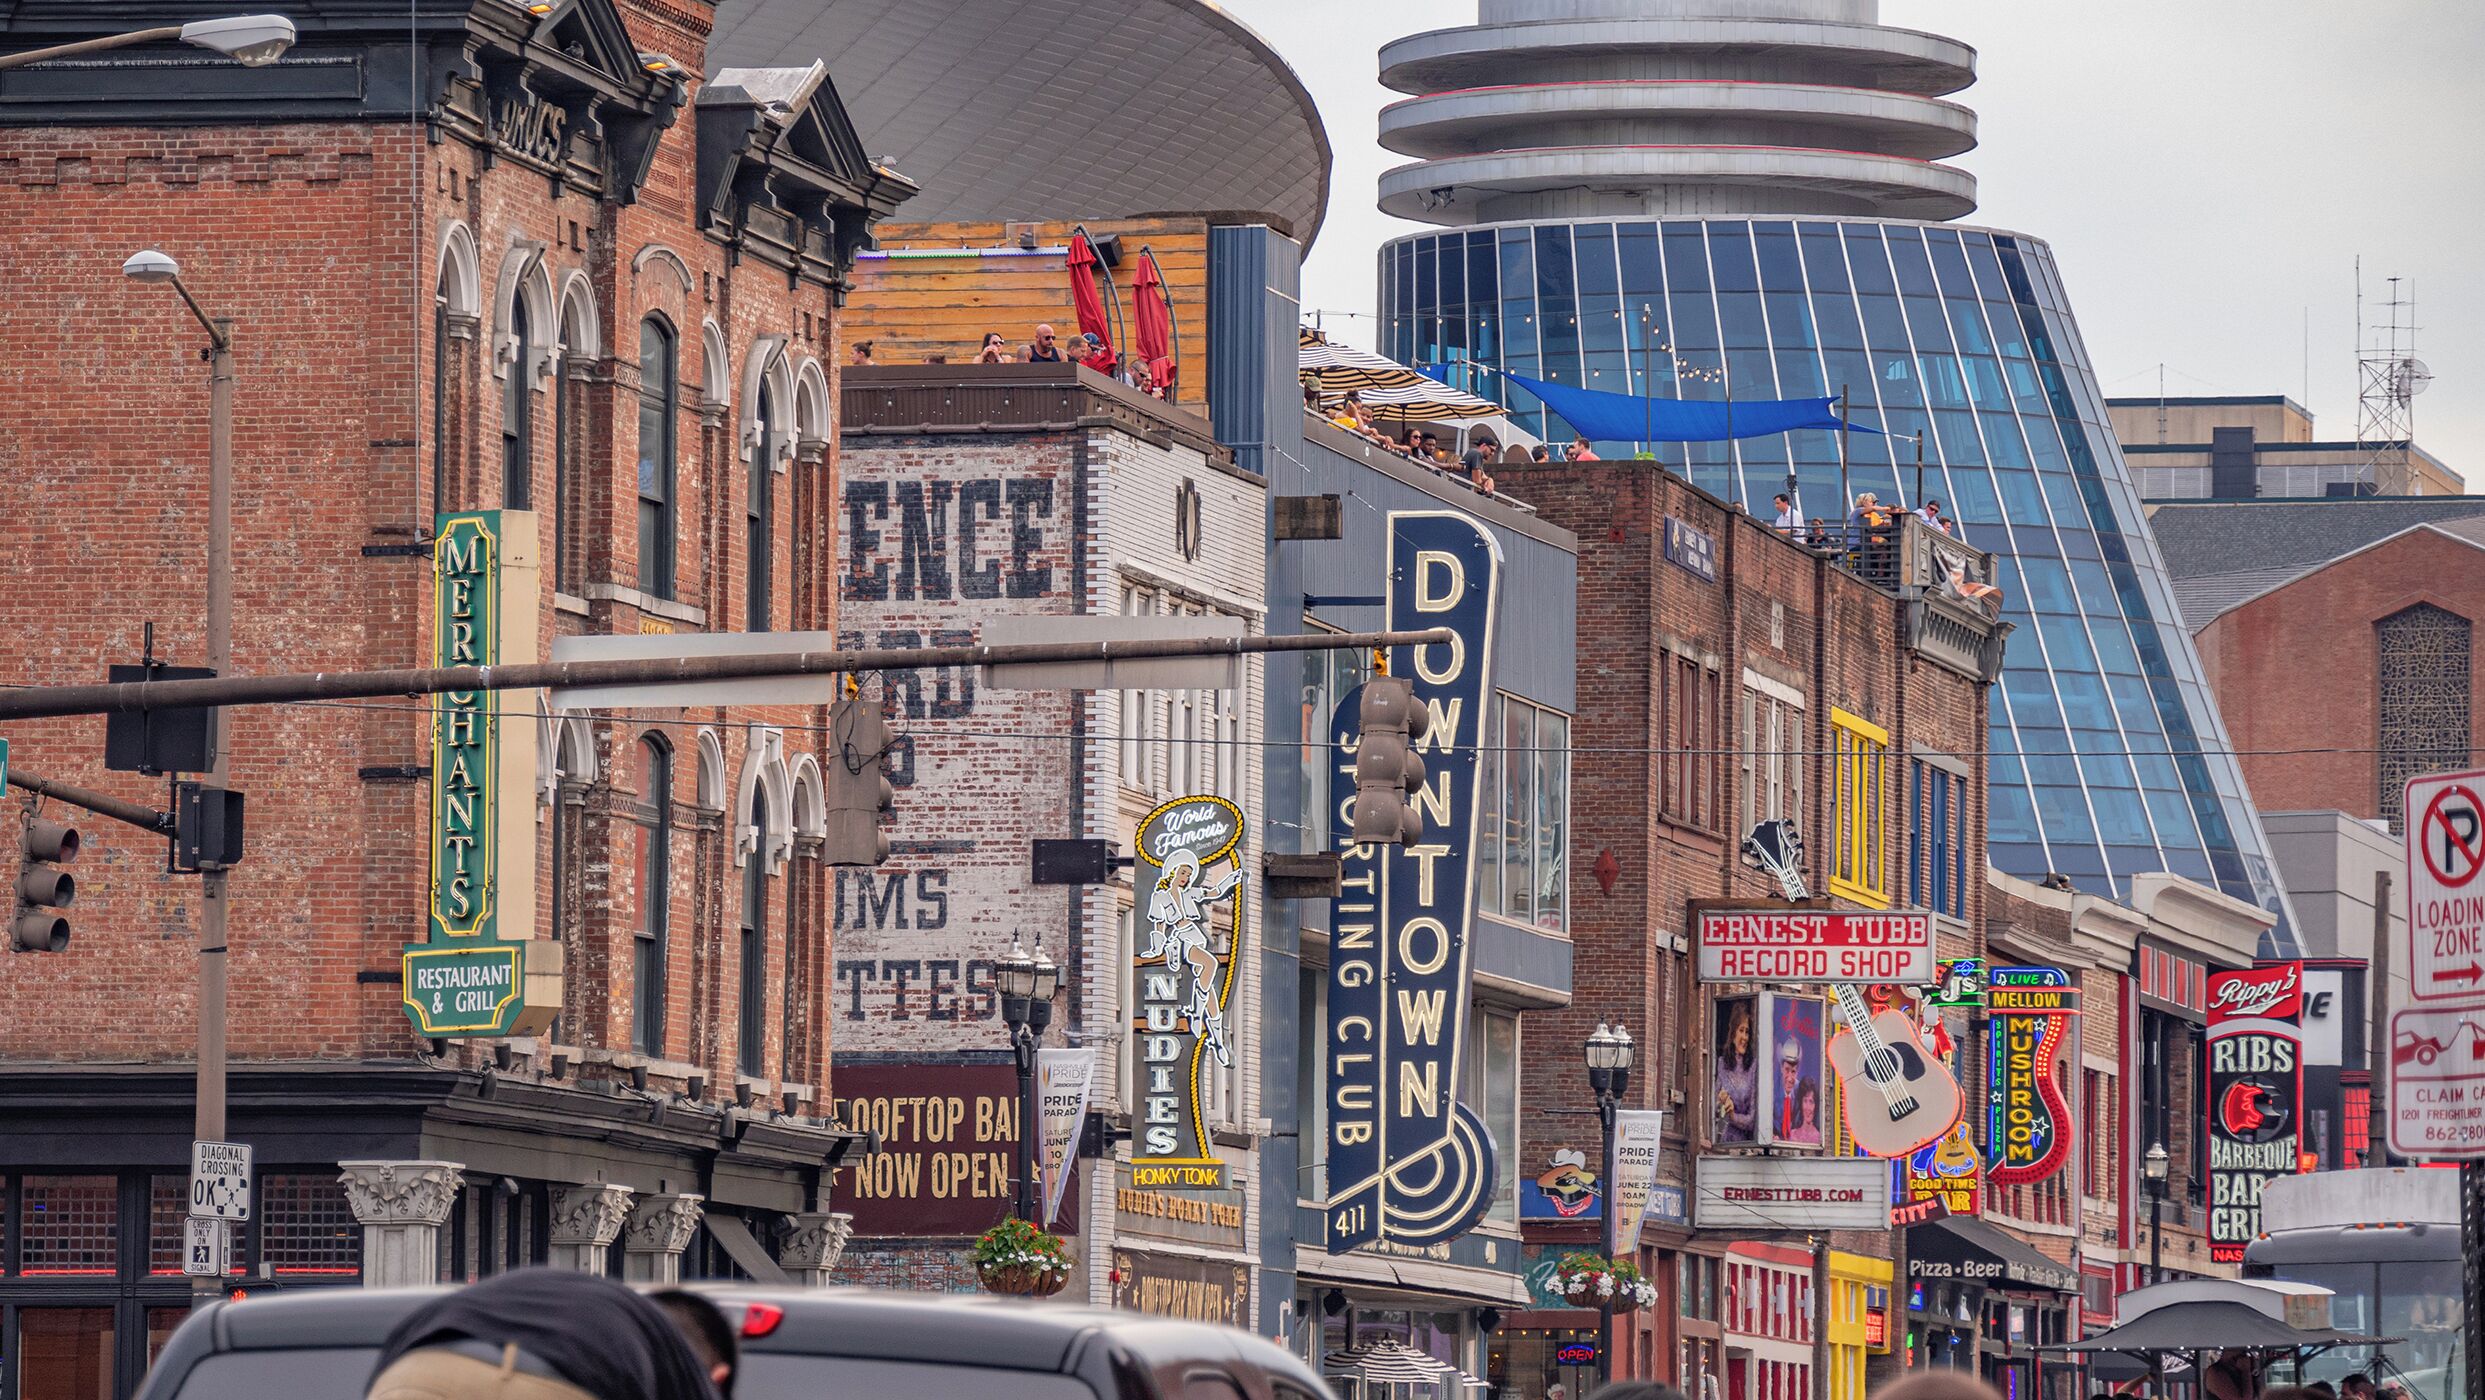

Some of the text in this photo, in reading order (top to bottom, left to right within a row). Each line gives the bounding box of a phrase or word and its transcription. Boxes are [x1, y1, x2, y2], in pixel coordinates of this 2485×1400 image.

[839, 479, 1053, 600] ENCE
[1164, 804, 1216, 832] World
[1154, 821, 1230, 857] Famous
[1397, 550, 1466, 1117] DOWNTOWN
[1705, 916, 1927, 944] ERNEST TUBB
[2434, 926, 2482, 957] ZONE
[1721, 950, 1827, 976] RECORD
[1841, 951, 1911, 977] SHOP
[418, 965, 512, 988] RESTAURANT
[2010, 974, 2039, 985] LIVE
[2209, 966, 2298, 1008] Rippy's
[431, 989, 497, 1014] & GRILL
[1993, 991, 2062, 1008] MELLOW
[1144, 972, 1183, 1154] NUDIES
[2213, 1037, 2294, 1073] RIBS
[1053, 1069, 1088, 1079] PRIDE
[1335, 1016, 1373, 1146] CLUB
[1044, 1093, 1082, 1106] PRIDE
[2008, 1017, 2034, 1161] MUSHROOM
[2416, 1087, 2464, 1103] CLAIM
[975, 1096, 1019, 1142] BA
[2401, 1107, 2482, 1120] 1201 FREIGHTLINER
[2426, 1125, 2485, 1141] 862-780
[201, 1144, 244, 1161] DIAGONAL
[1619, 1147, 1655, 1157] PRIDE
[2211, 1134, 2297, 1170] BARBEQUE
[200, 1160, 244, 1177] CROSSING
[1619, 1159, 1653, 1167] PARADE
[855, 1152, 1009, 1199] NOW OPEN
[1133, 1166, 1219, 1186] HONKY TONK
[1616, 1182, 1640, 1190] JUNE
[1909, 1178, 1977, 1190] GOOD TIME
[193, 1178, 217, 1206] OK
[1723, 1186, 1863, 1202] ERNESTTUBB.COM
[1117, 1187, 1241, 1229] NUDIE'S HONKY TONK
[192, 1220, 213, 1229] CROSS
[1335, 1204, 1366, 1238] 411
[194, 1228, 211, 1238] ONLY
[190, 1263, 211, 1272] SIGNAL
[1909, 1260, 1953, 1277] Pizza
[1963, 1261, 2004, 1278] Beer
[1557, 1349, 1594, 1361] OPEN
